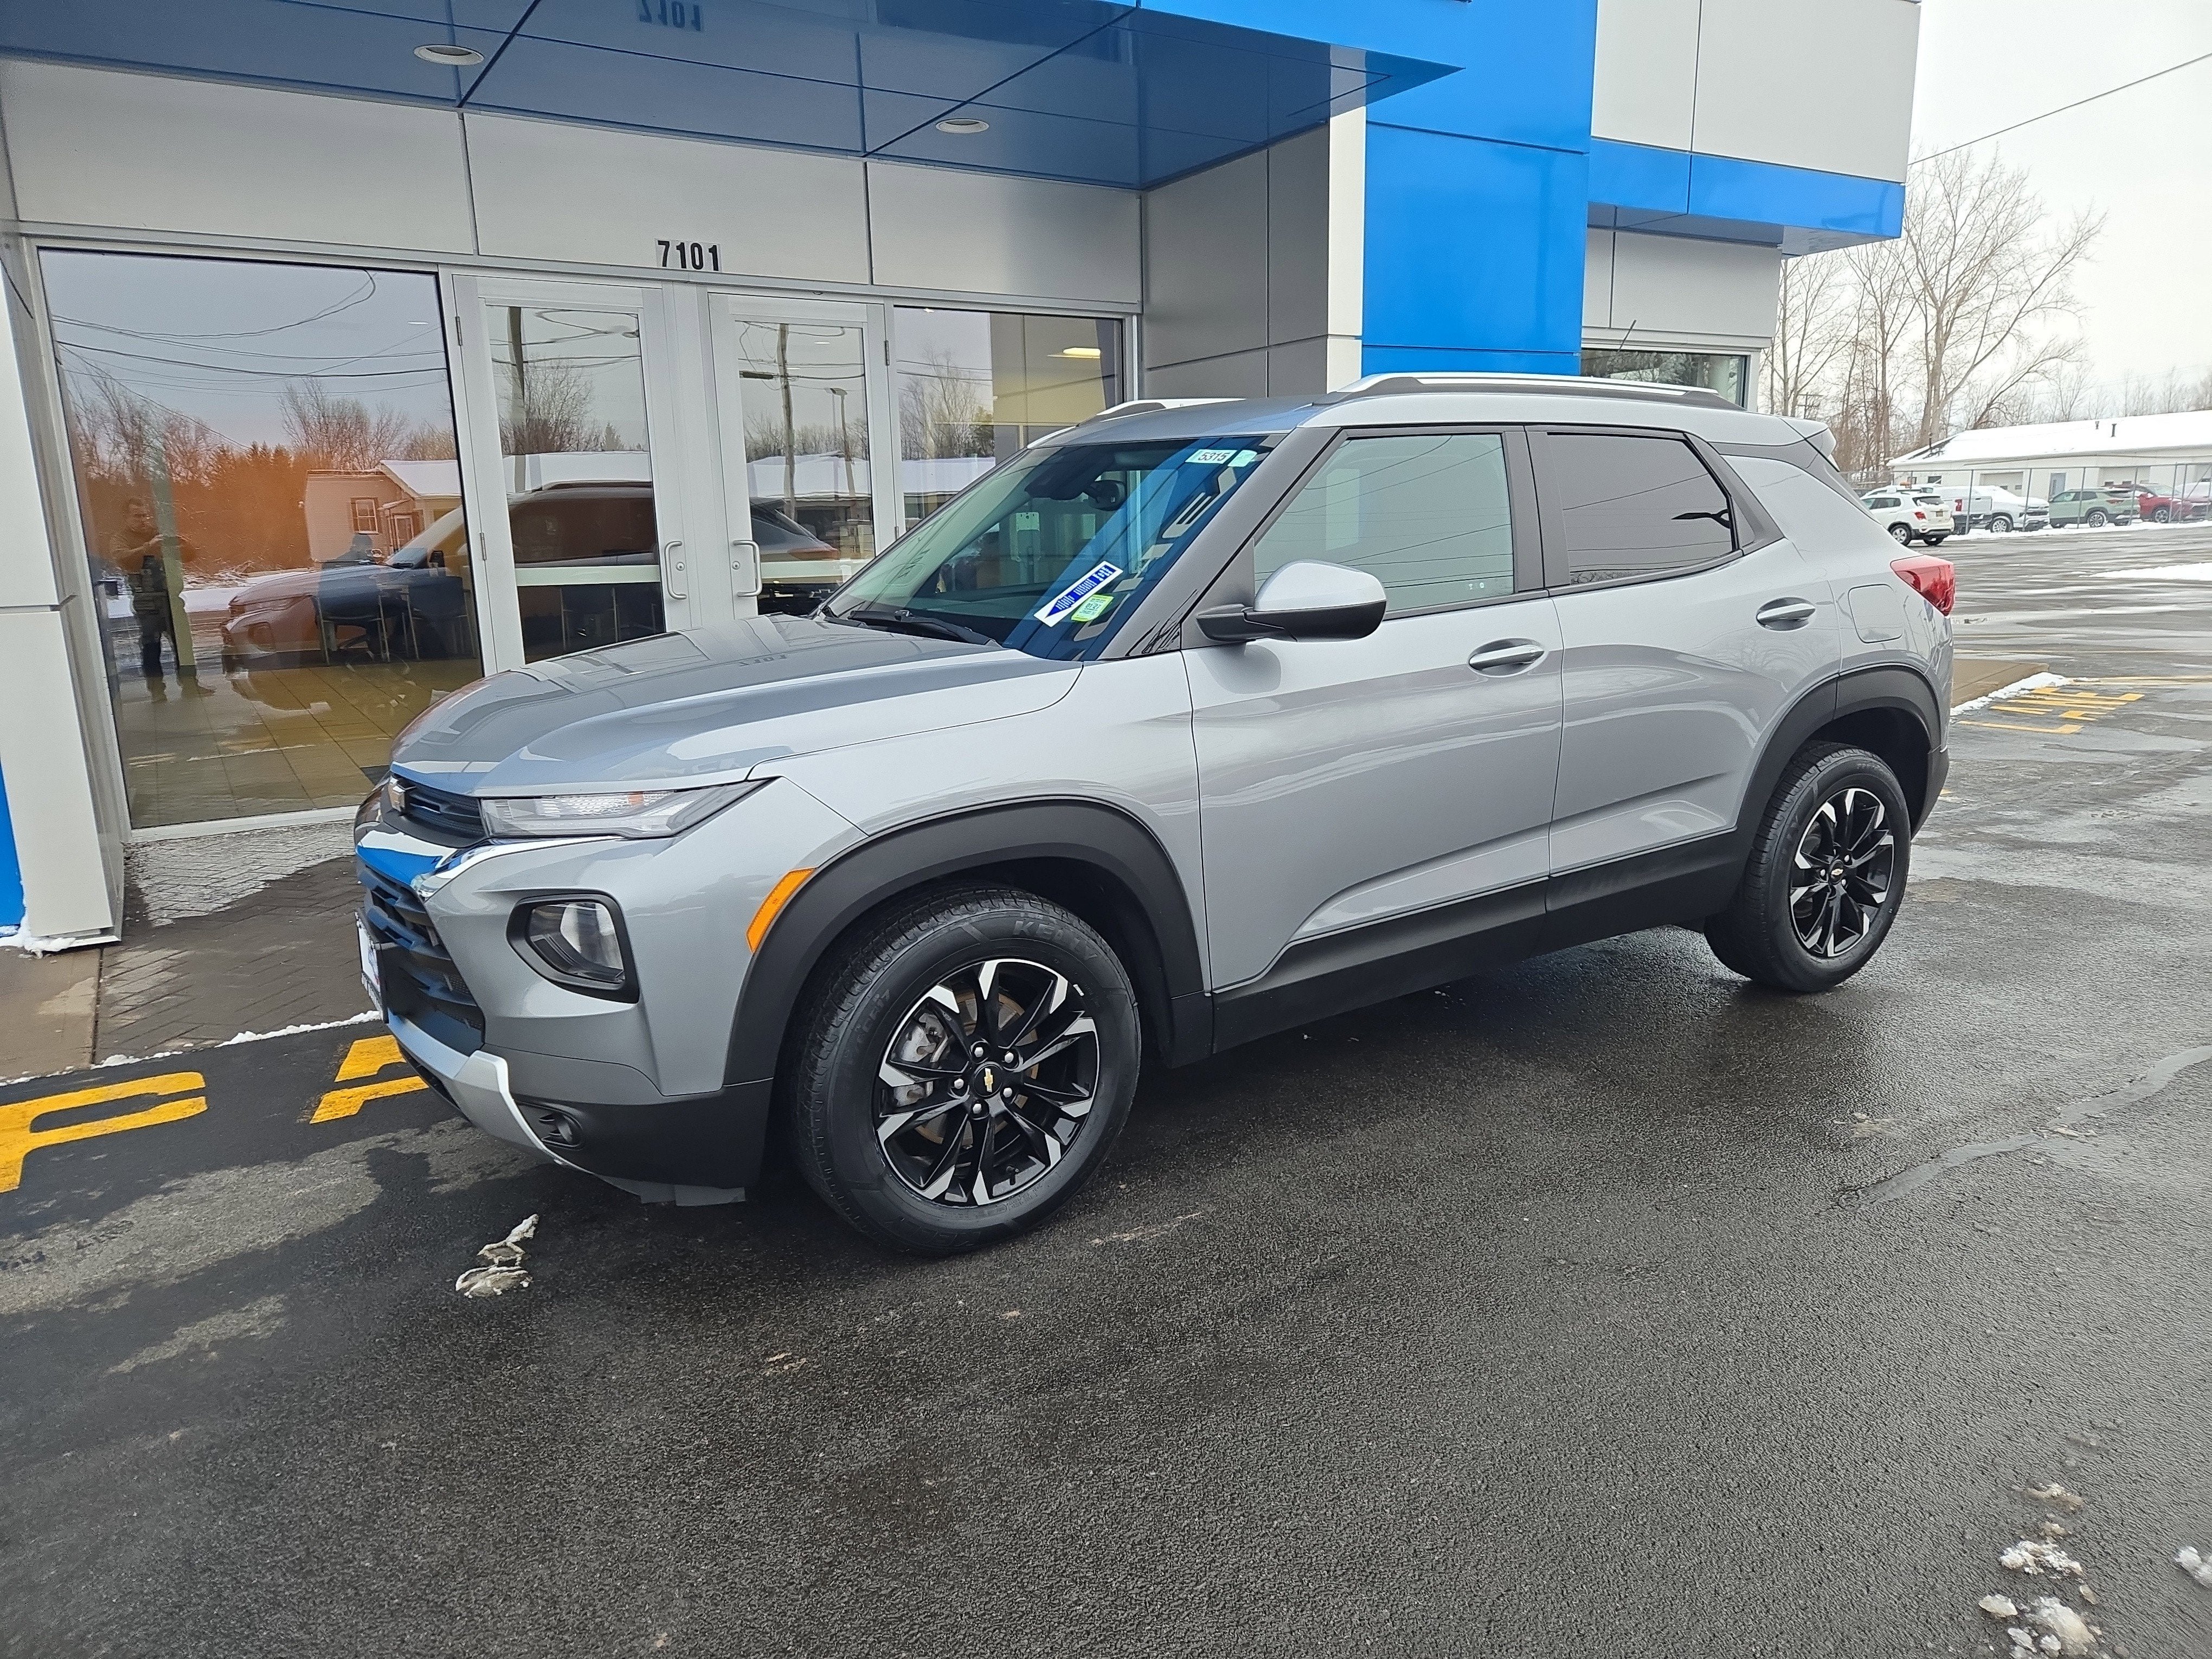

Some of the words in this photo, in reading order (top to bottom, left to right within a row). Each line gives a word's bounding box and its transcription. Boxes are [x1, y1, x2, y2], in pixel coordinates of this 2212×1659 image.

[658, 240, 718, 271] 7101
[1198, 452, 1230, 461] 5315
[1013, 920, 1098, 961] KELLY
